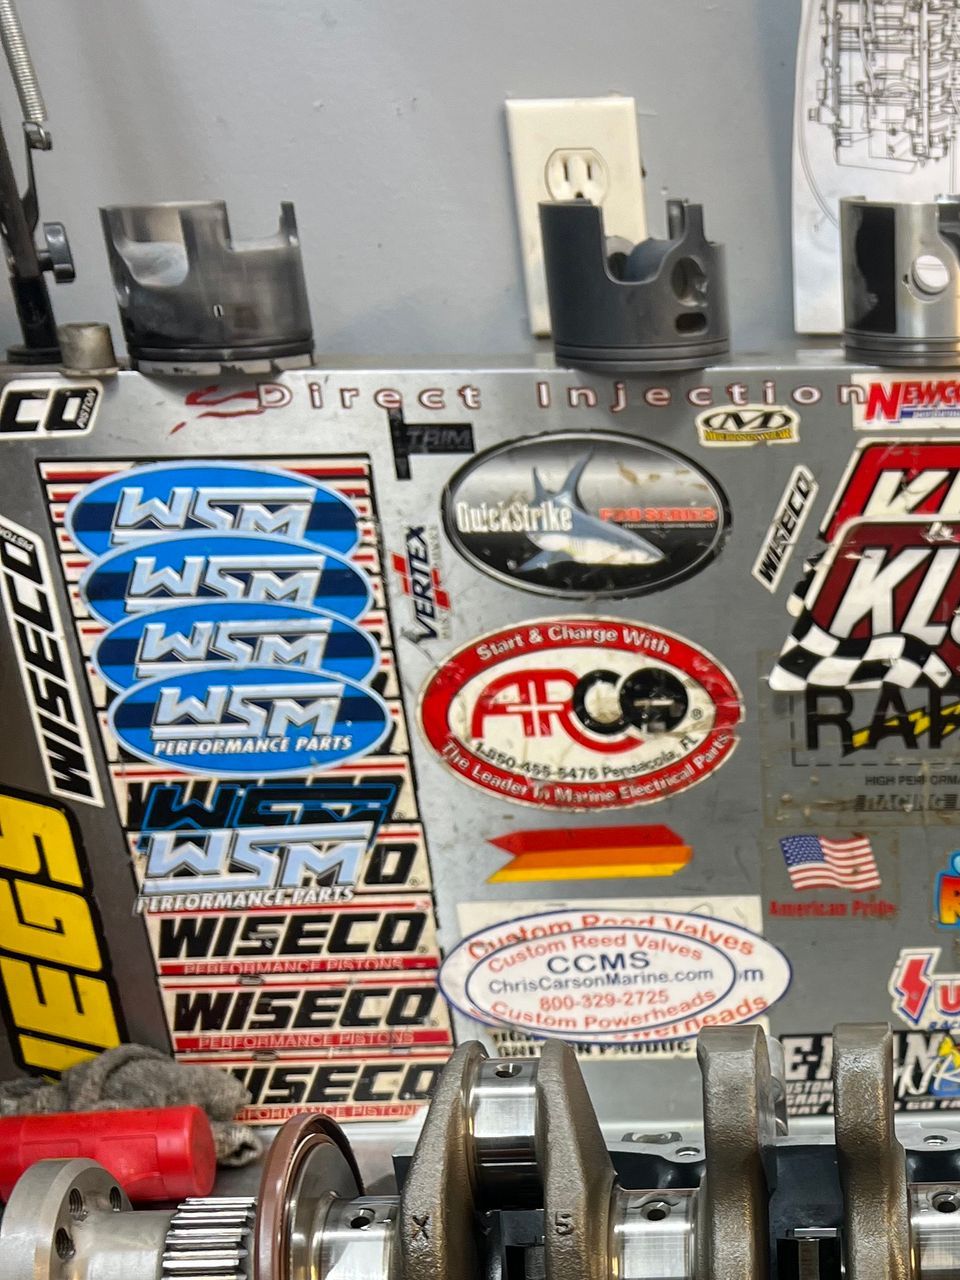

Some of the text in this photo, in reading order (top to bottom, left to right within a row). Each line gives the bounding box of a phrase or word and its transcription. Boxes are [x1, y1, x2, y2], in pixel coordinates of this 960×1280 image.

[257, 381, 867, 413] Direct Injection
[108, 486, 317, 547] WSM
[456, 500, 573, 533] QuickStrike
[757, 473, 813, 585] WISECO
[123, 554, 327, 614] WSM
[405, 524, 439, 642] VERTEX
[133, 617, 334, 679] WSM
[476, 625, 671, 661] Start & Charge With
[0, 541, 96, 798] WISECO
[150, 682, 346, 741] WSM
[153, 734, 353, 757] PERFORMANCE PARTS
[470, 763, 529, 797] Leader
[553, 786, 616, 803] Marine
[617, 762, 697, 799] Electrical
[695, 732, 731, 770] Parts
[864, 774, 896, 786] HIGH
[142, 821, 374, 894] WSM
[293, 886, 355, 904] PARTS
[769, 899, 897, 918] American Pride
[159, 911, 429, 958] WISECO
[466, 919, 573, 961] Custom
[661, 916, 756, 956] Valves
[487, 933, 704, 974] Custom Reed Valves
[184, 958, 405, 975] PERFORMANCE PISTONS
[488, 966, 715, 996] ChrisCarsonMarine.com
[547, 951, 652, 976] CCMS
[174, 986, 439, 1032] WISECO
[490, 988, 717, 1029] Custom Powerheads
[538, 989, 670, 1012] 800-329-2725
[198, 1031, 415, 1050] PERFORMANCE PISTONS
[229, 1063, 447, 1105] ISECO
[554, 1211, 575, 1236] 5
